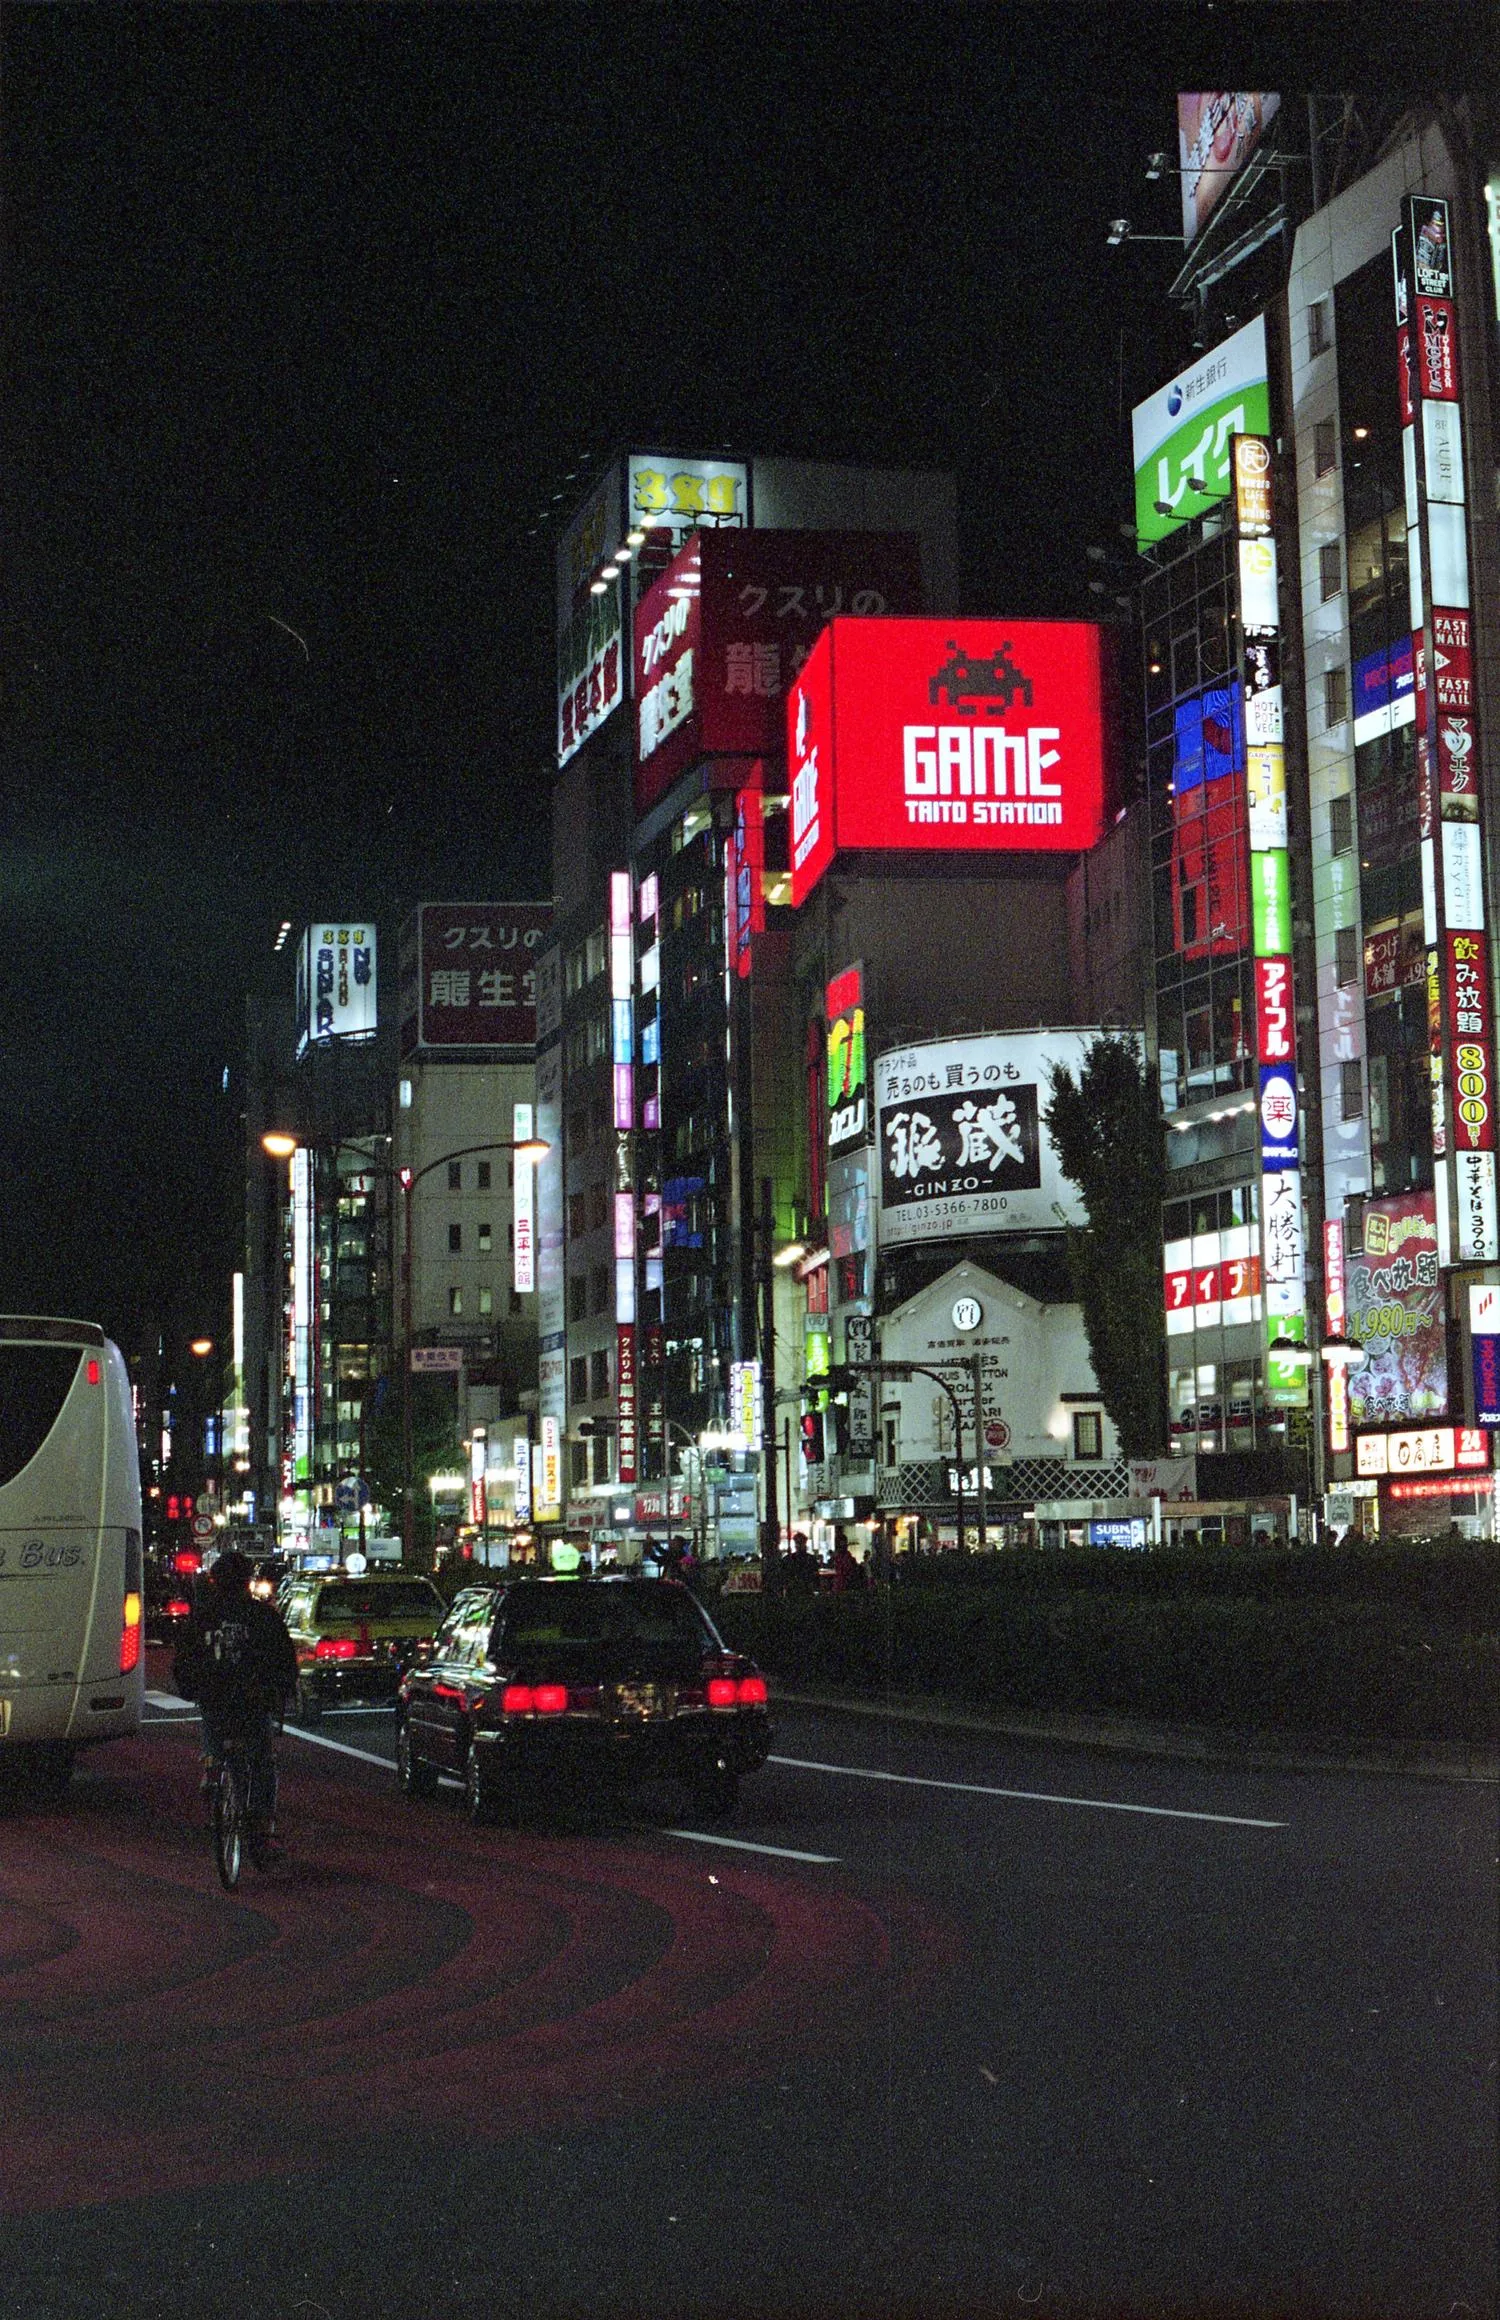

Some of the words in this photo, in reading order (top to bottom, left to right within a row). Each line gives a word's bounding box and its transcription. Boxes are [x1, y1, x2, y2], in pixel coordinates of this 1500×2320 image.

[1185, 357, 1227, 401] 新生銀行
[1435, 619, 1467, 632] FAST
[1435, 633, 1467, 646] NAIL
[1438, 678, 1470, 691] FAST
[1439, 692, 1470, 705] NAIL
[903, 725, 1062, 797] GAME
[905, 800, 966, 824] TAITO
[973, 801, 1062, 825] STATION
[1454, 937, 1482, 1033] 飲み放題
[1263, 962, 1289, 1057] アイフル
[887, 1072, 940, 1101] 売るのも
[945, 1062, 1021, 1089] 買うのも
[1269, 1178, 1301, 1275] 大勝軒
[947, 1383, 993, 1394] ROLX
[1461, 1431, 1480, 1451] 24
